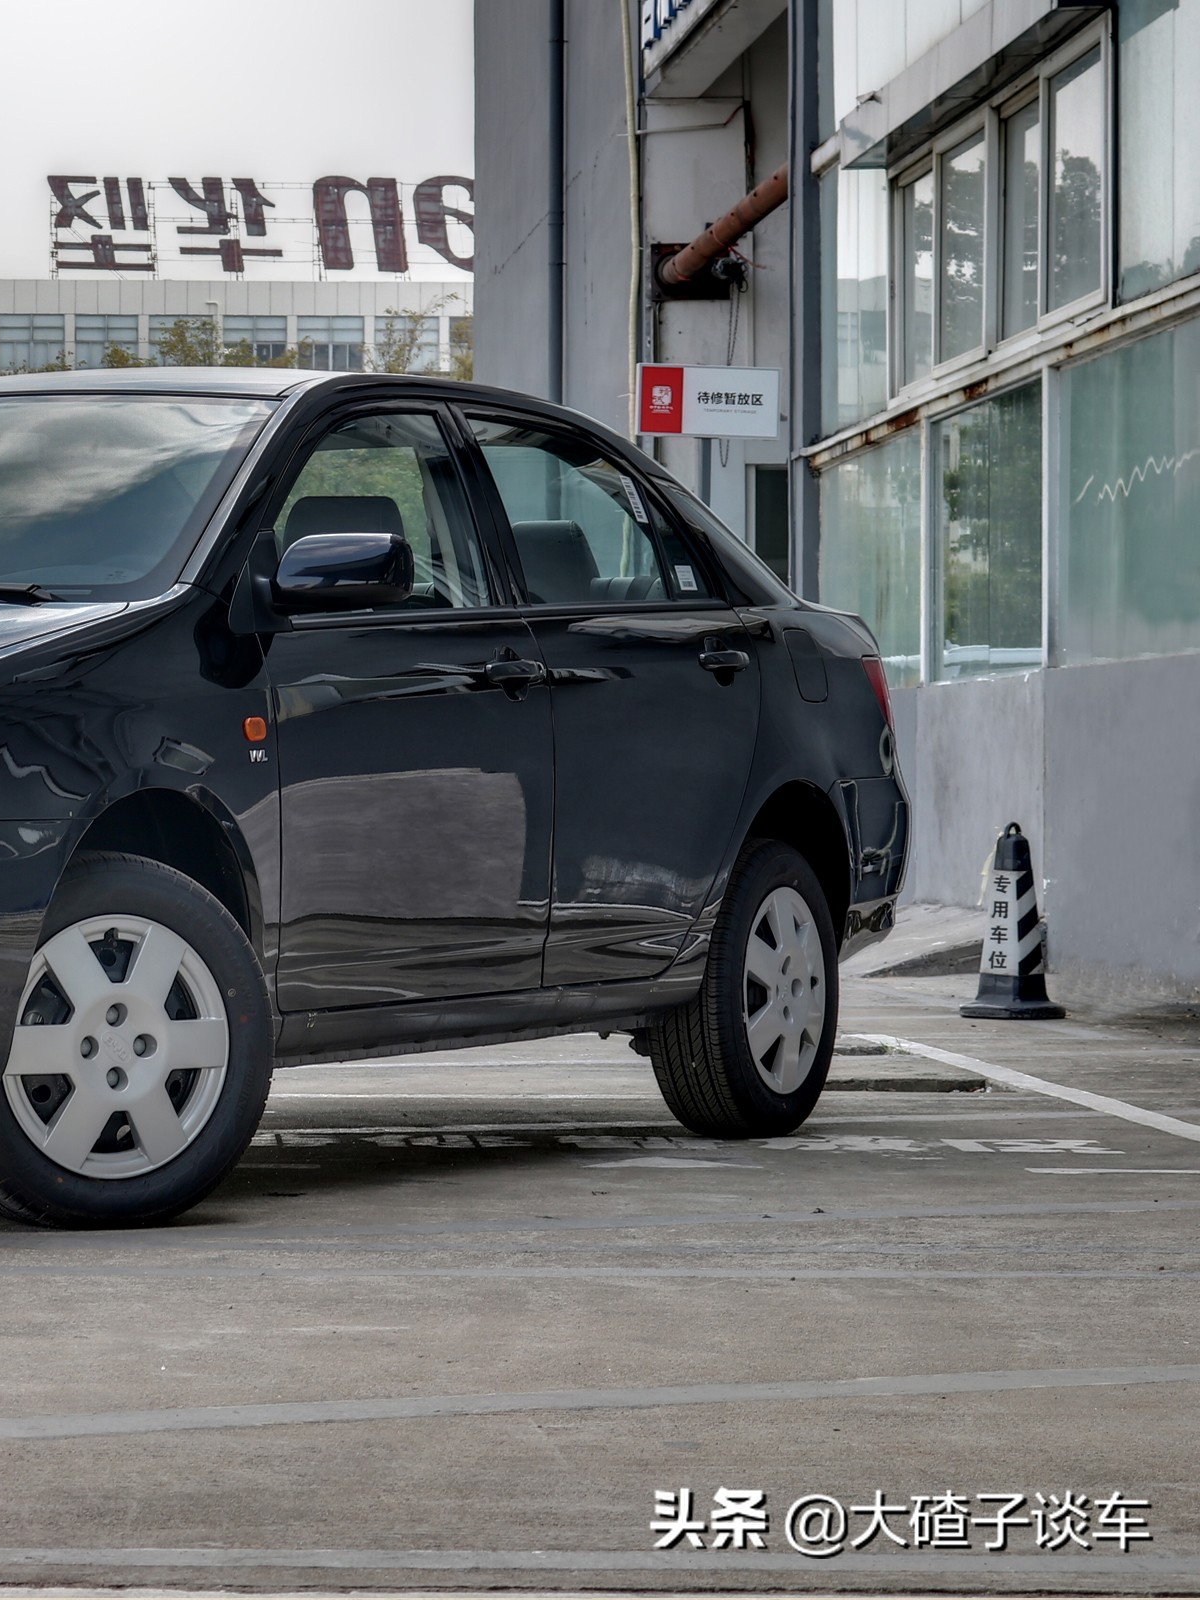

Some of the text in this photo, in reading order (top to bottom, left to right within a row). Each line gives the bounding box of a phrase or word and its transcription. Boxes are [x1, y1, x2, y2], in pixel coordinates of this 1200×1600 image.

[697, 391, 764, 406] 待修暂放区
[988, 875, 1011, 970] 专用车位
